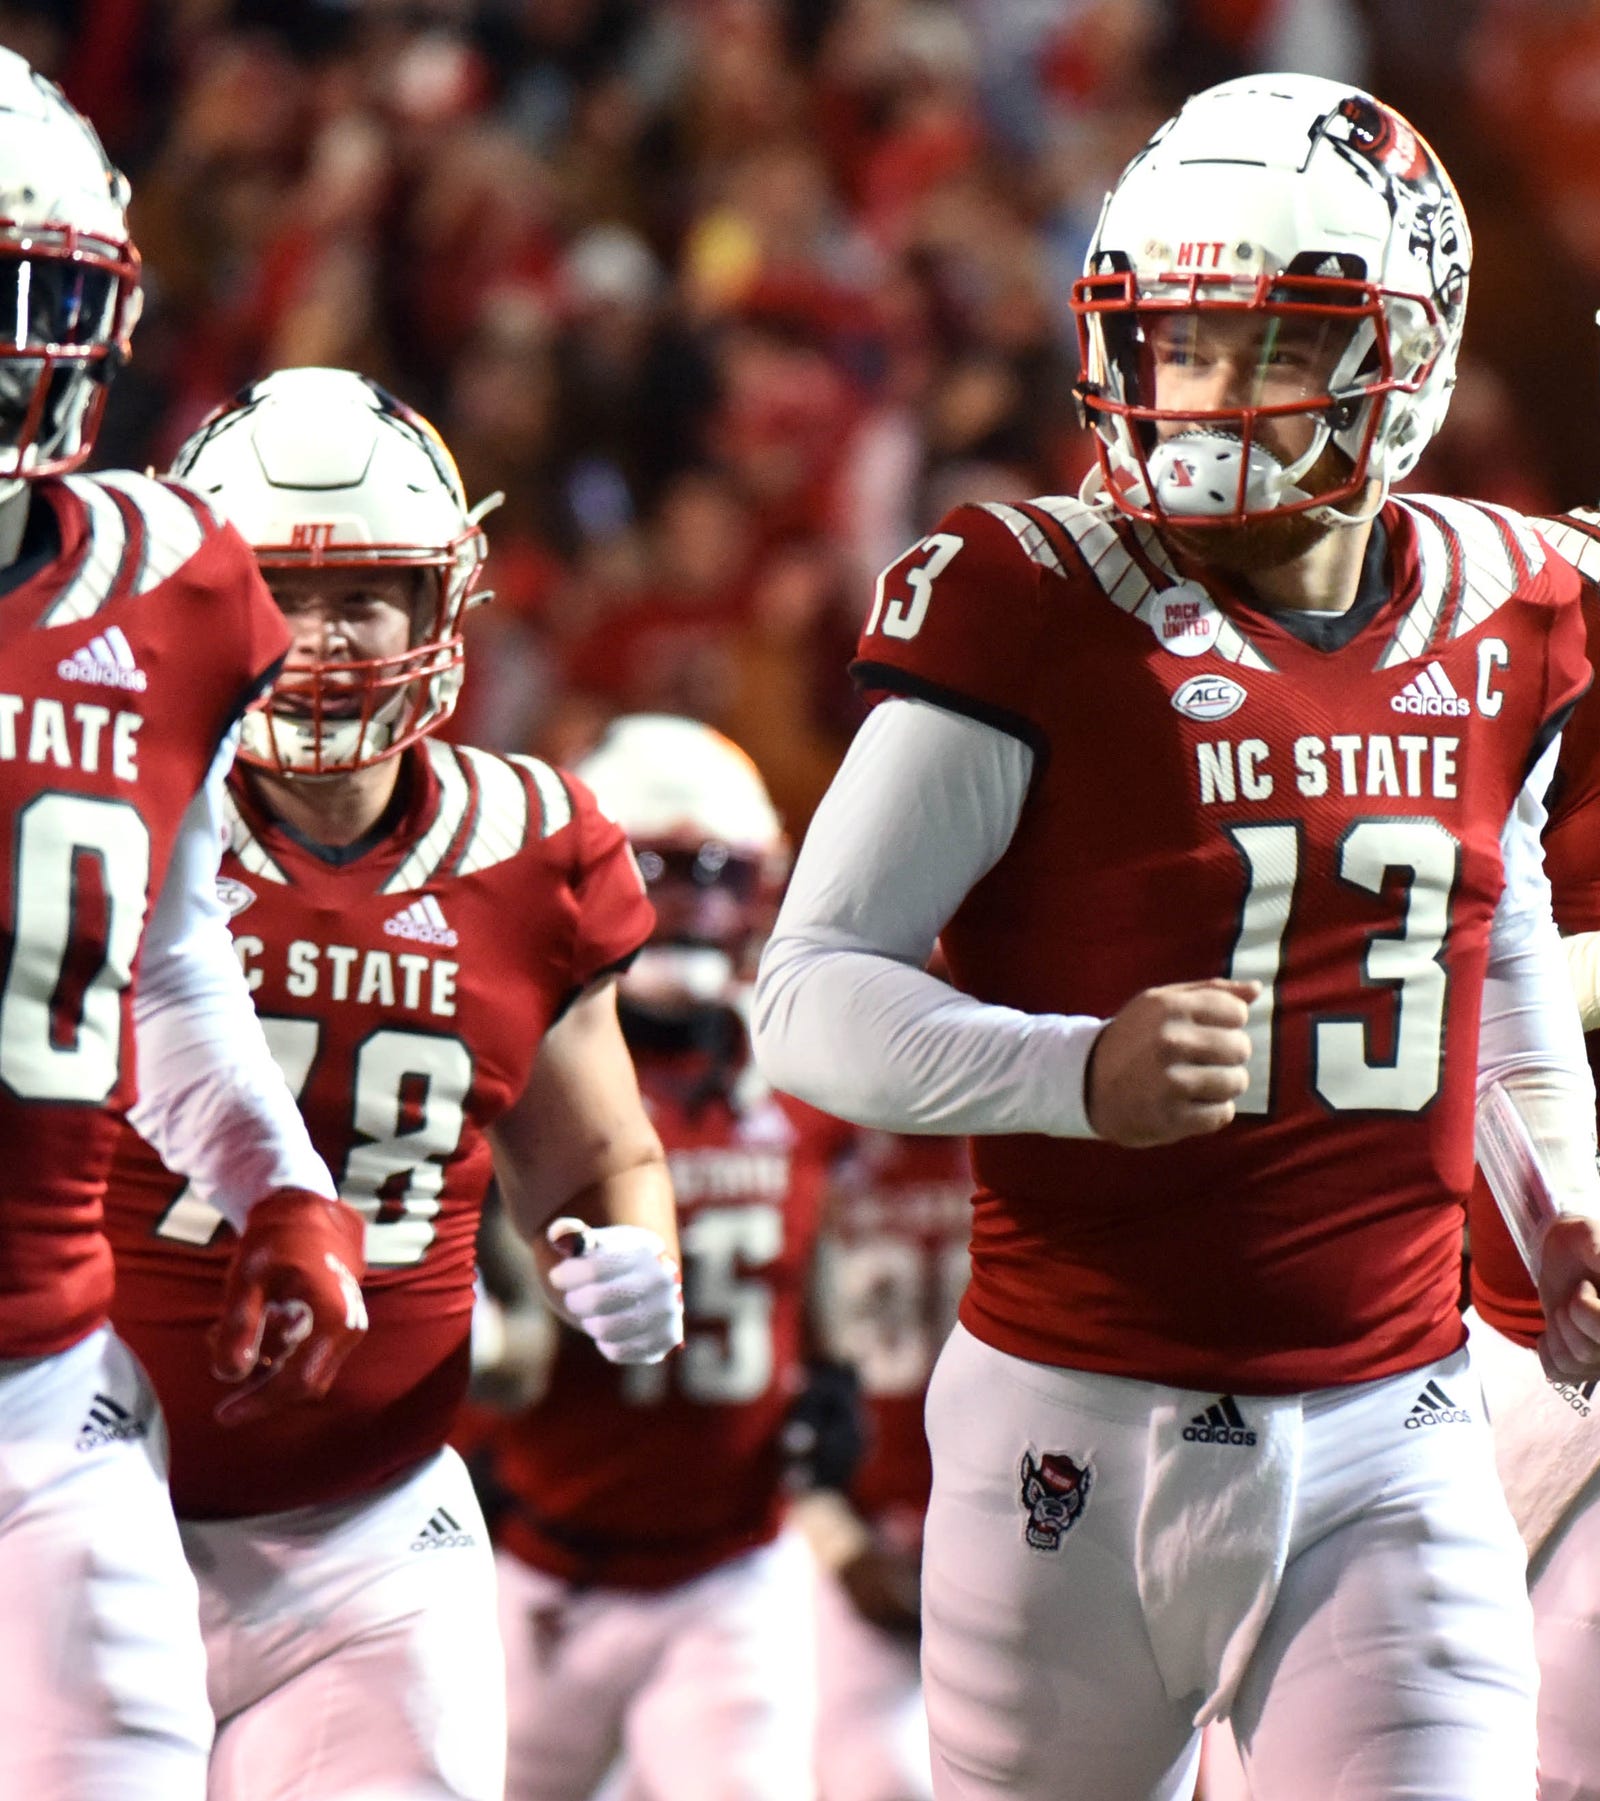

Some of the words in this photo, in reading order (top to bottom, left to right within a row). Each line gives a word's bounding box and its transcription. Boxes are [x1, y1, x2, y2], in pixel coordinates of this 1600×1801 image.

[1177, 242, 1226, 267] HTT
[1165, 602, 1201, 620] PACK
[1162, 618, 1211, 639] UNITED
[57, 658, 148, 693] adidas
[1476, 637, 1511, 719] C
[1186, 685, 1232, 705] ACC
[1390, 695, 1471, 717] adidas
[1195, 741, 1273, 804] NC
[1294, 734, 1460, 800] STATE
[383, 918, 458, 948] adidas
[233, 935, 264, 992] C
[286, 939, 459, 1017] STATE
[1225, 817, 1463, 1116] 13
[1547, 1380, 1592, 1418] didas
[1404, 1407, 1472, 1430] adidas
[1182, 1424, 1257, 1447] adidas
